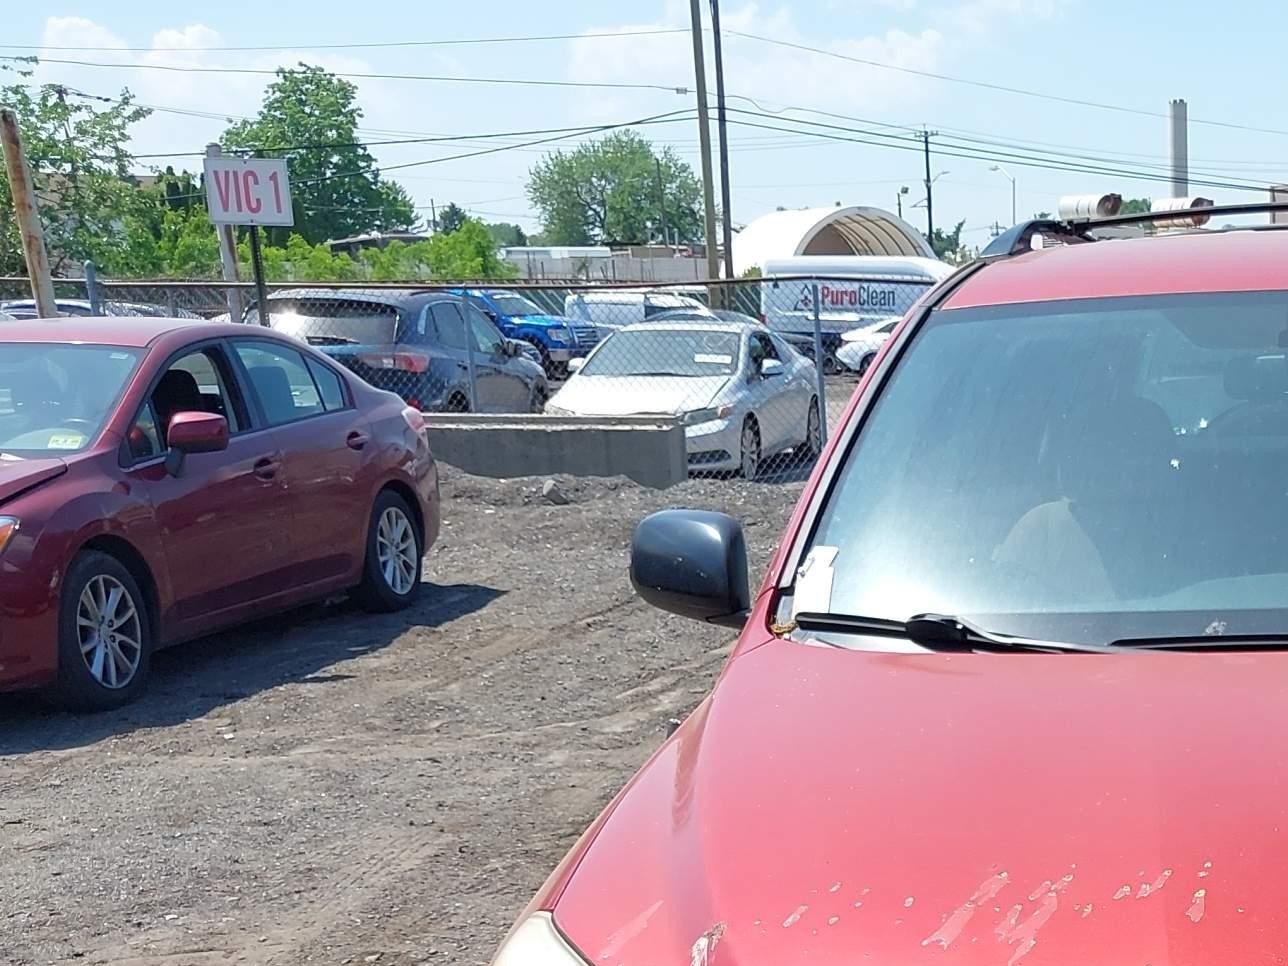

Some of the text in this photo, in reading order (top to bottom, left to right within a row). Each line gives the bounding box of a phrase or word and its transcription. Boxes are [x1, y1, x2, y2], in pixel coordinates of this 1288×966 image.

[213, 170, 282, 214] VIC 1
[821, 286, 896, 307] PuroClean
